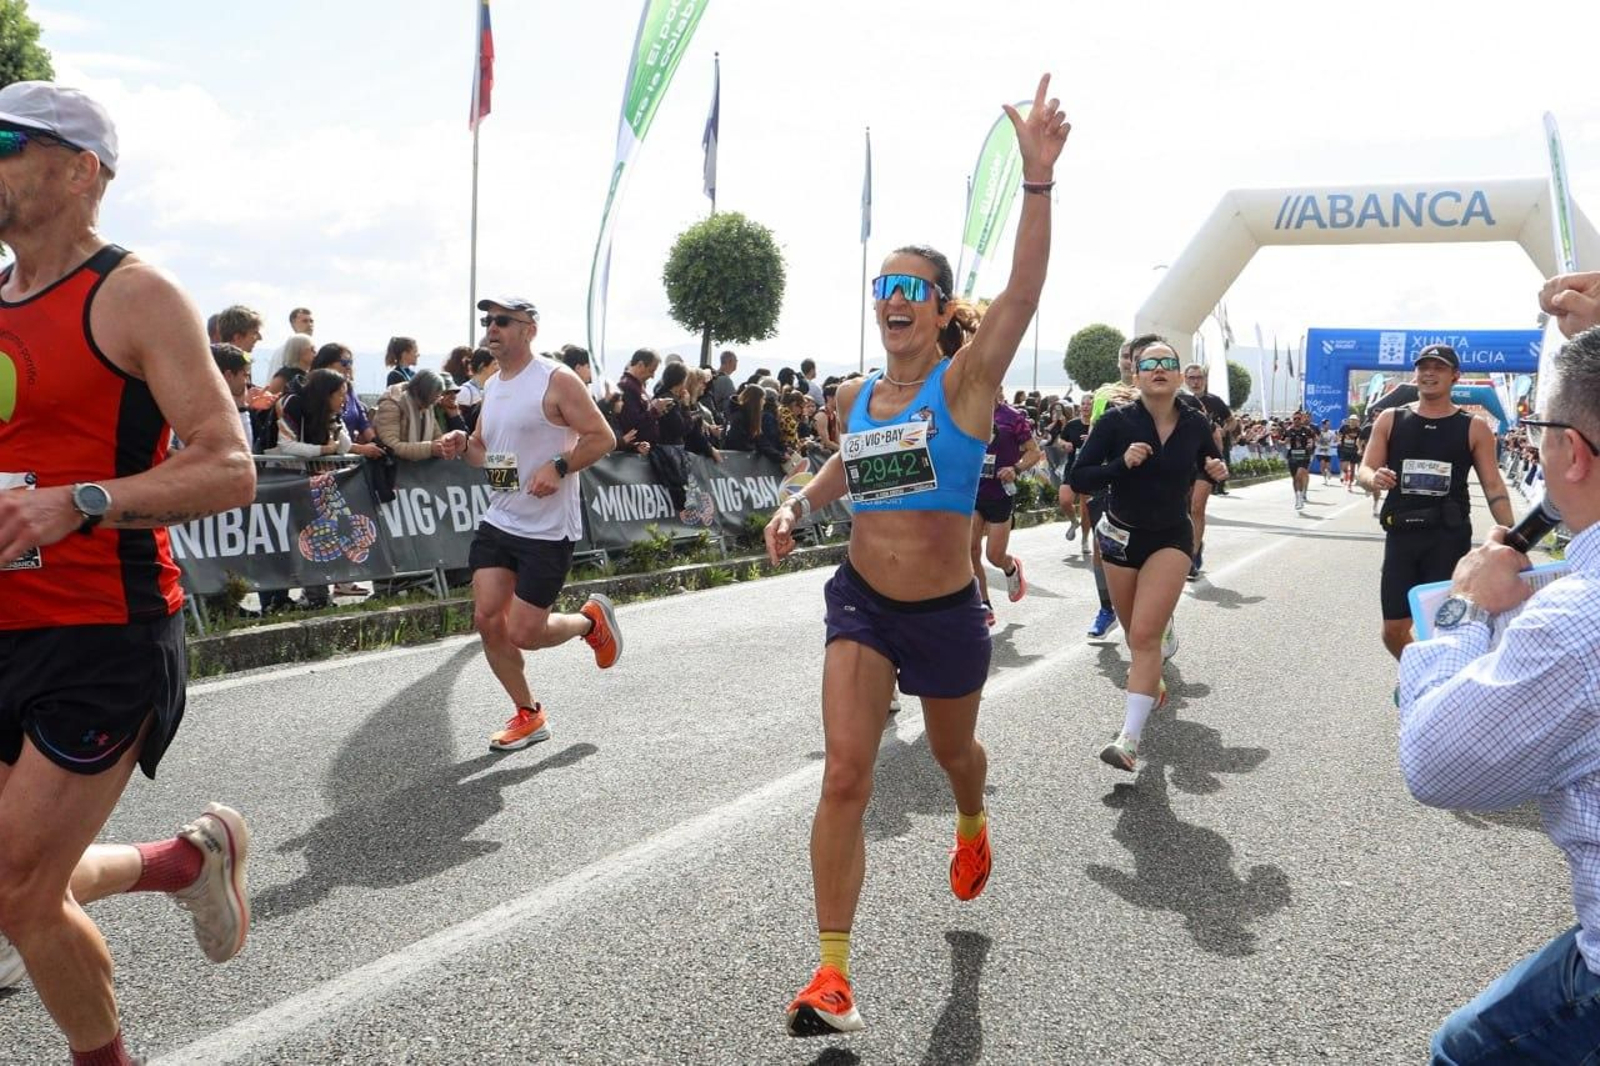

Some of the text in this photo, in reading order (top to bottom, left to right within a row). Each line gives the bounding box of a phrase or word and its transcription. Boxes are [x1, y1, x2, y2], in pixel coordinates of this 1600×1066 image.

[661, 0, 696, 67] colab
[646, 43, 662, 66] El
[1411, 335, 1470, 349] XUNTA
[1460, 350, 1506, 364] LICIA
[849, 440, 860, 453] 25
[865, 432, 880, 447] VIG
[885, 428, 905, 443] BAY
[860, 452, 920, 483] 2942
[597, 484, 676, 522] MINIBAY
[710, 475, 782, 513] VIG BAY
[379, 487, 436, 538] VIG
[169, 503, 291, 559] NIBAY
